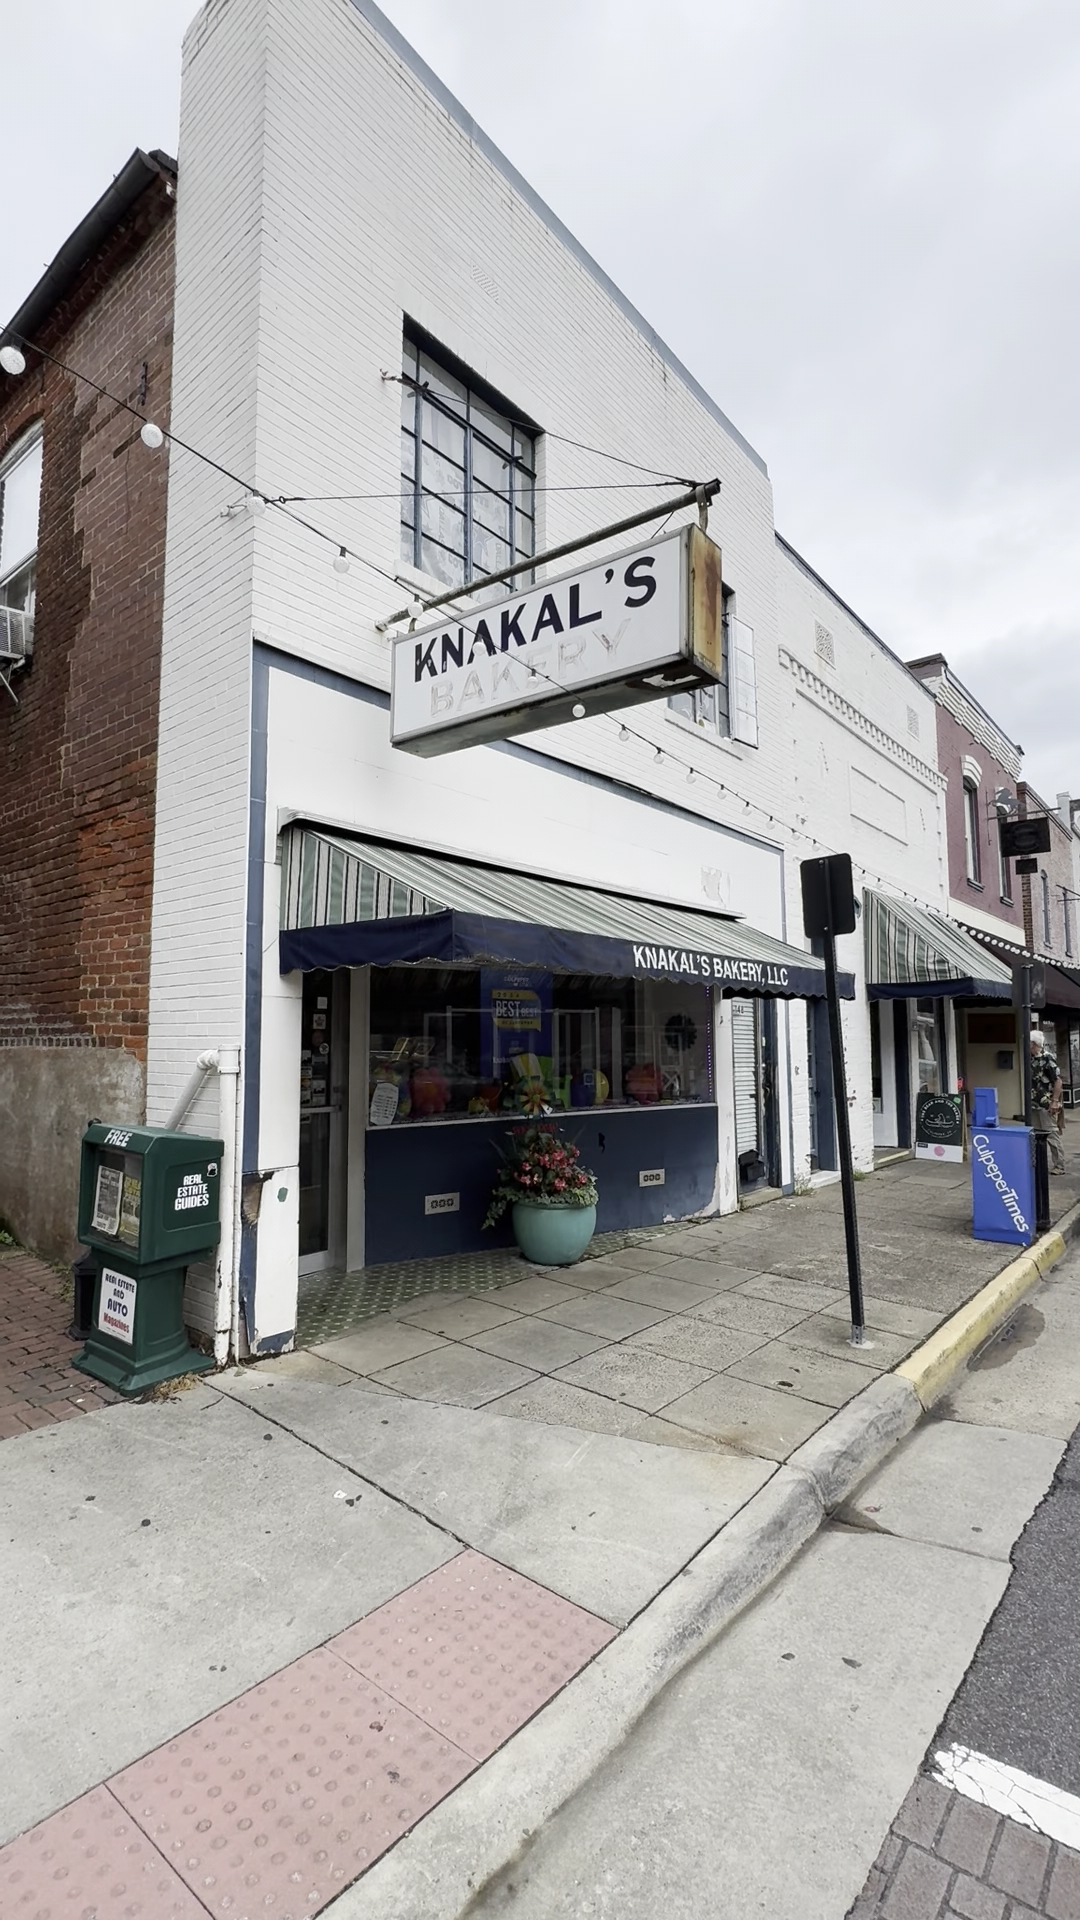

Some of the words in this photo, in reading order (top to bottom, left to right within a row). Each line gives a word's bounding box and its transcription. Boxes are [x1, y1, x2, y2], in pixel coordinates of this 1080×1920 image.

[414, 556, 657, 683] KNAKAL'S
[430, 617, 632, 718] BAKERY
[633, 945, 711, 977] KNAKAL'S
[713, 957, 766, 987] BAKERY,
[767, 965, 789, 986] LLC
[496, 1000, 520, 1017] BEST
[104, 1129, 133, 1147] FREE
[183, 1173, 203, 1186] REAL
[177, 1183, 208, 1198] ESTATE
[174, 1194, 209, 1211] GUIDES
[105, 1273, 117, 1285] REAL
[117, 1278, 135, 1293] ESTATE
[113, 1288, 125, 1300] AND
[107, 1298, 129, 1317] AUTO
[103, 1312, 130, 1334] Magazines
